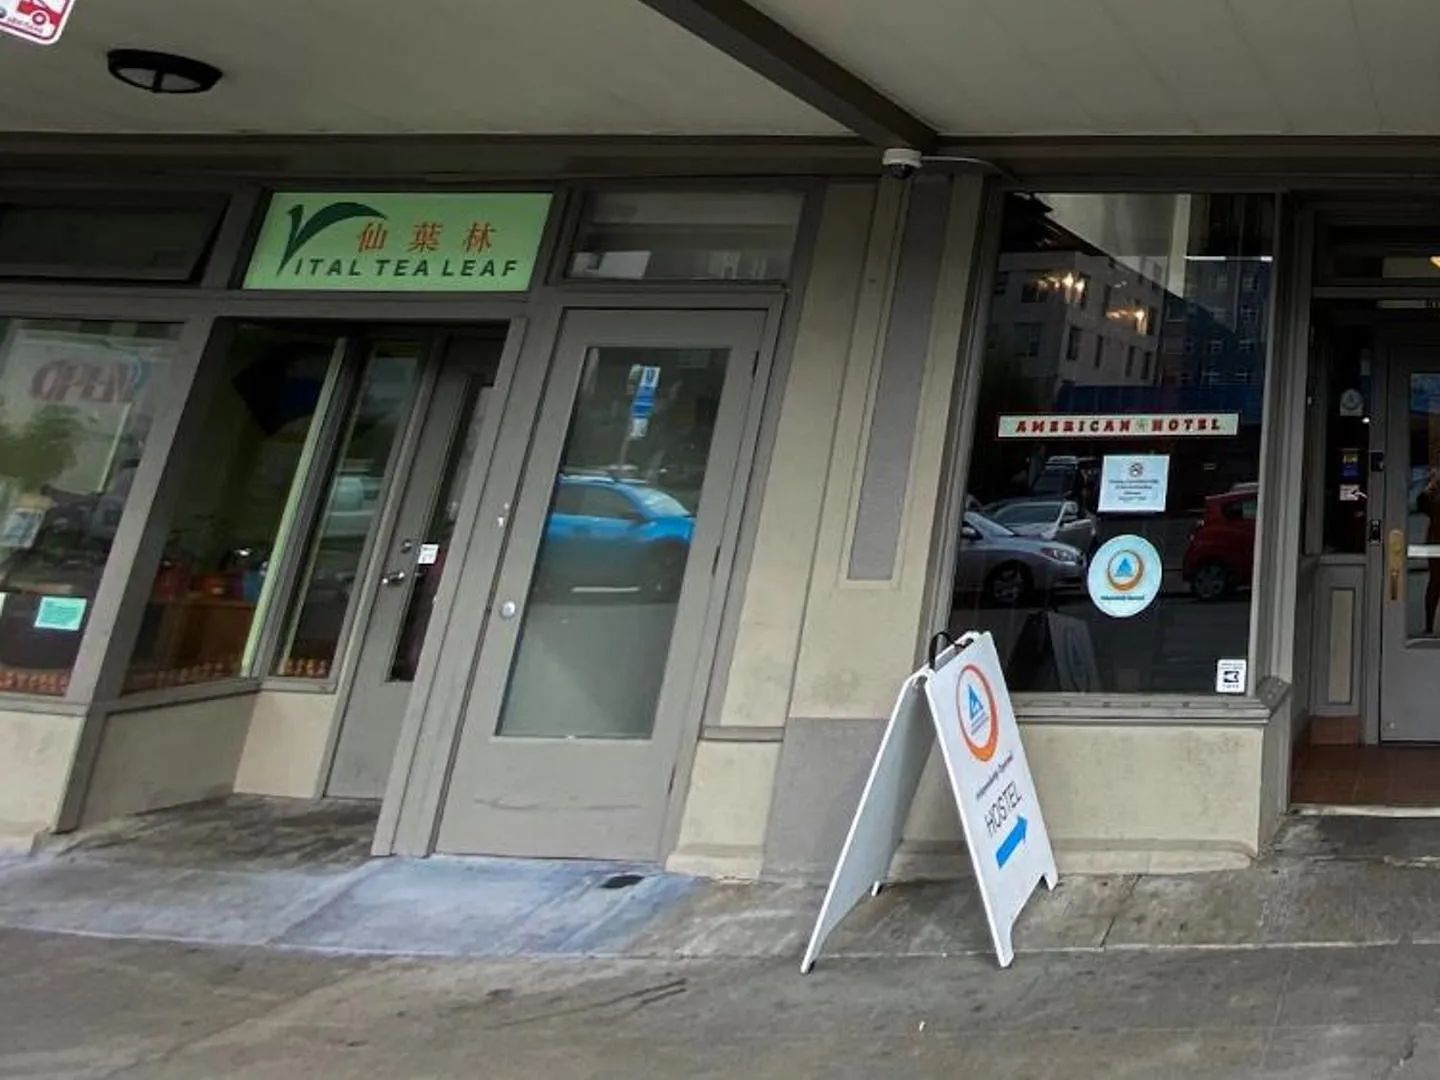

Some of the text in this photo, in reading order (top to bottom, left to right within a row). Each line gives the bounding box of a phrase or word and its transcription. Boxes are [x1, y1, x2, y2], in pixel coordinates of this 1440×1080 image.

[375, 259, 429, 277] TEA
[442, 259, 518, 277] LEAF
[1015, 418, 1222, 434] AMERICAN HOTEL
[984, 780, 1022, 838] HOSTEL
